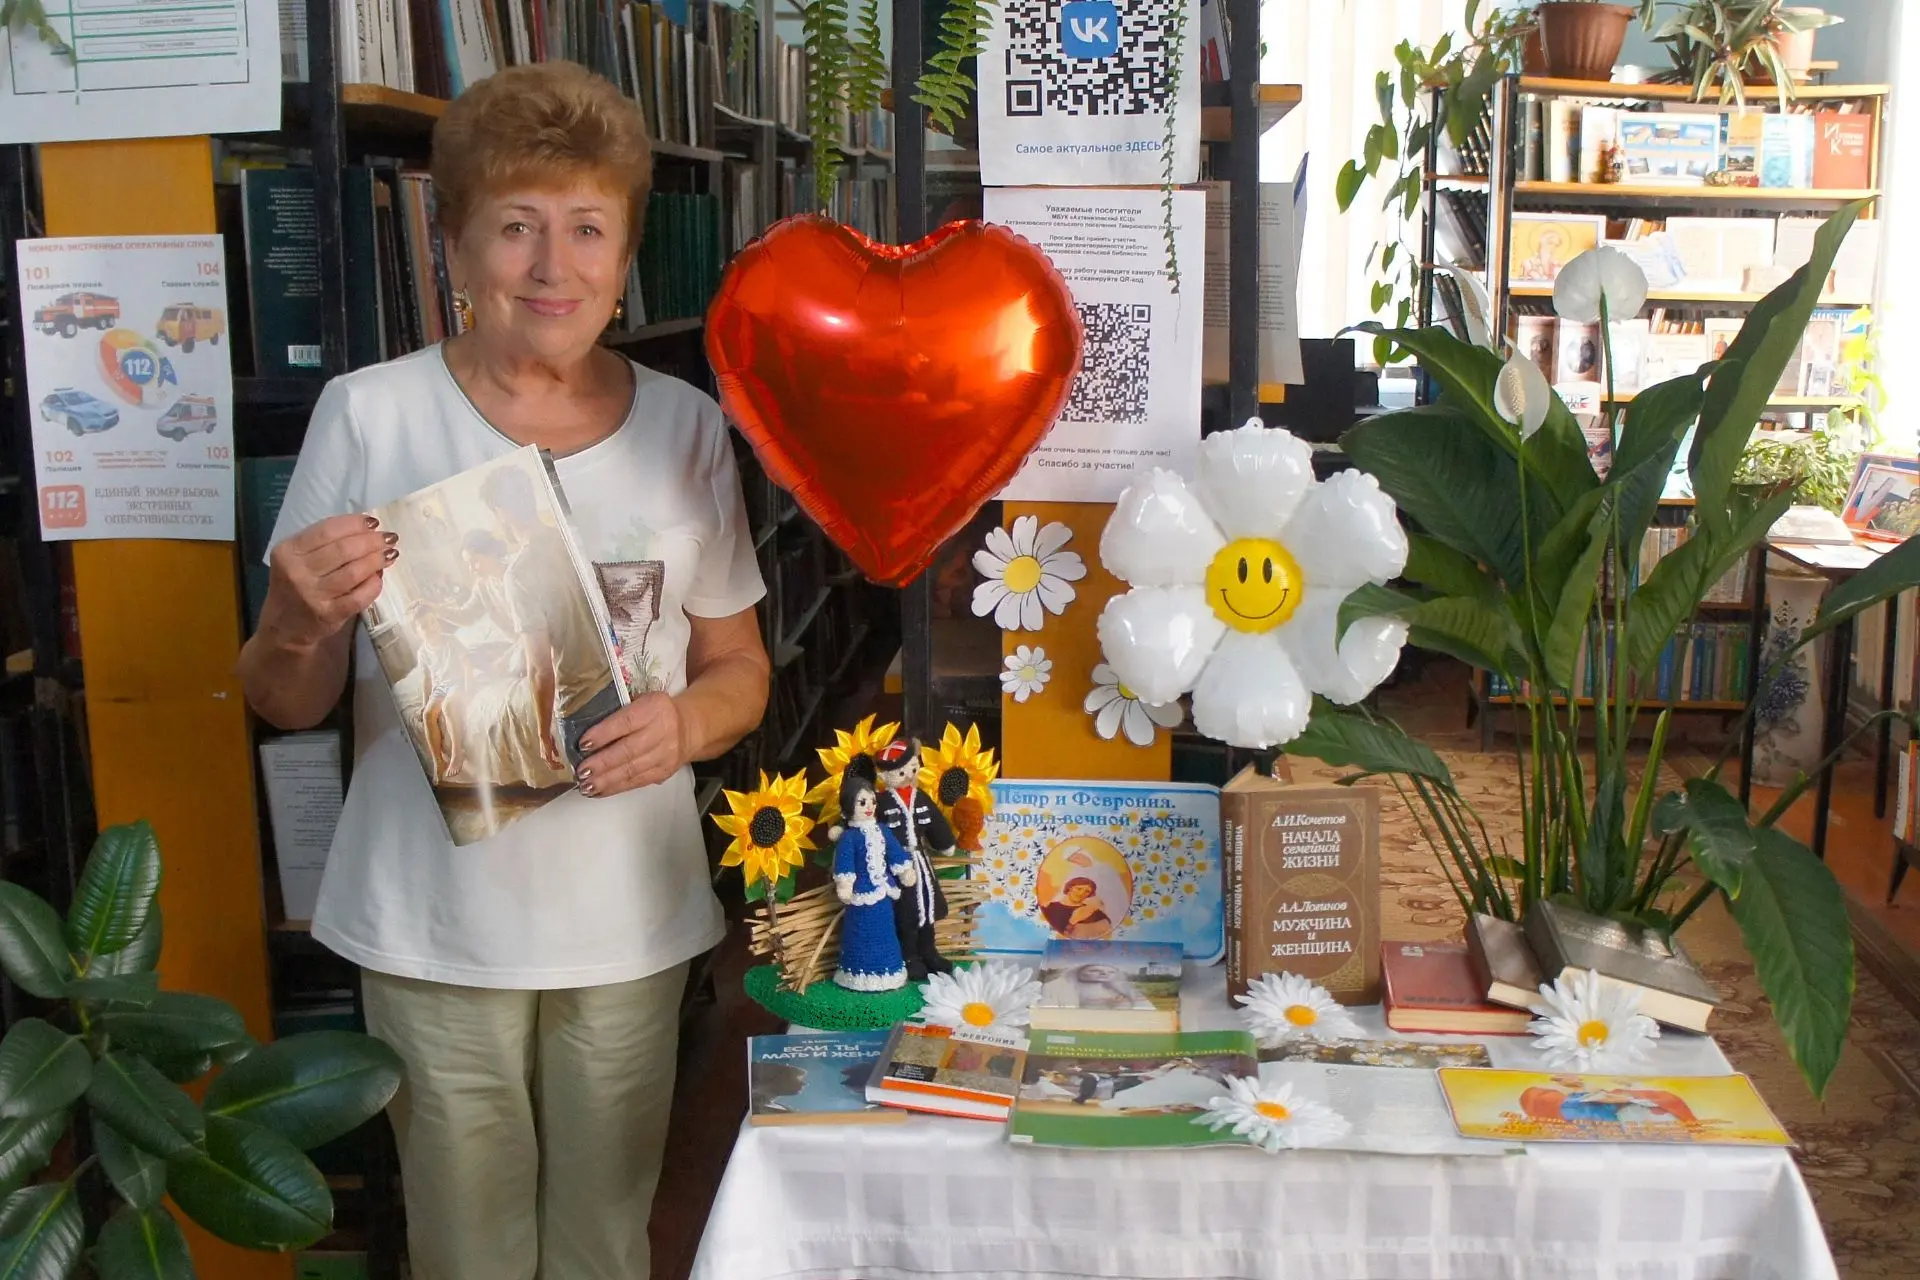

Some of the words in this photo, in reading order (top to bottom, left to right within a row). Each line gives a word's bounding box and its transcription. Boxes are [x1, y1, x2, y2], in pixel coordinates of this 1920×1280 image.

[1016, 143, 1053, 154] Самое
[1056, 143, 1122, 155] актуальное
[1046, 205, 1093, 213] Уважаемые
[1095, 207, 1142, 215] посетители
[25, 266, 50, 280] 101
[197, 262, 220, 276] 104
[124, 358, 152, 376] 112
[46, 450, 74, 463] 102
[207, 446, 229, 459] 103
[1038, 459, 1079, 468] Спасибо
[1082, 461, 1092, 469] за
[1094, 462, 1135, 470] участие!
[95, 486, 140, 498] ЕДИНЫЙ
[145, 487, 179, 498] НОМЕР
[182, 487, 219, 497] ВЫЗОВА
[46, 490, 79, 509] 112
[997, 788, 1049, 808] Пётр
[1055, 794, 1067, 805] и
[1072, 792, 1176, 811] Феврония.
[985, 812, 1056, 827] стория
[1063, 814, 1131, 826] вечной
[1272, 814, 1346, 828] А.И.Кочетов
[1282, 830, 1341, 844] НАЧАЛА
[1282, 841, 1340, 854] семейной
[1282, 854, 1340, 869] ЖИЗНИ
[1273, 917, 1352, 932] МУЖЧИНА
[1307, 932, 1316, 941] и
[1272, 942, 1352, 956] ЖЕНЩИНА
[960, 1031, 1017, 1046] ФЕВРОНИЯ
[784, 1045, 828, 1053] ЕСЛИ
[833, 1044, 860, 1052] ТЫ
[762, 1052, 809, 1060] МАТЬ
